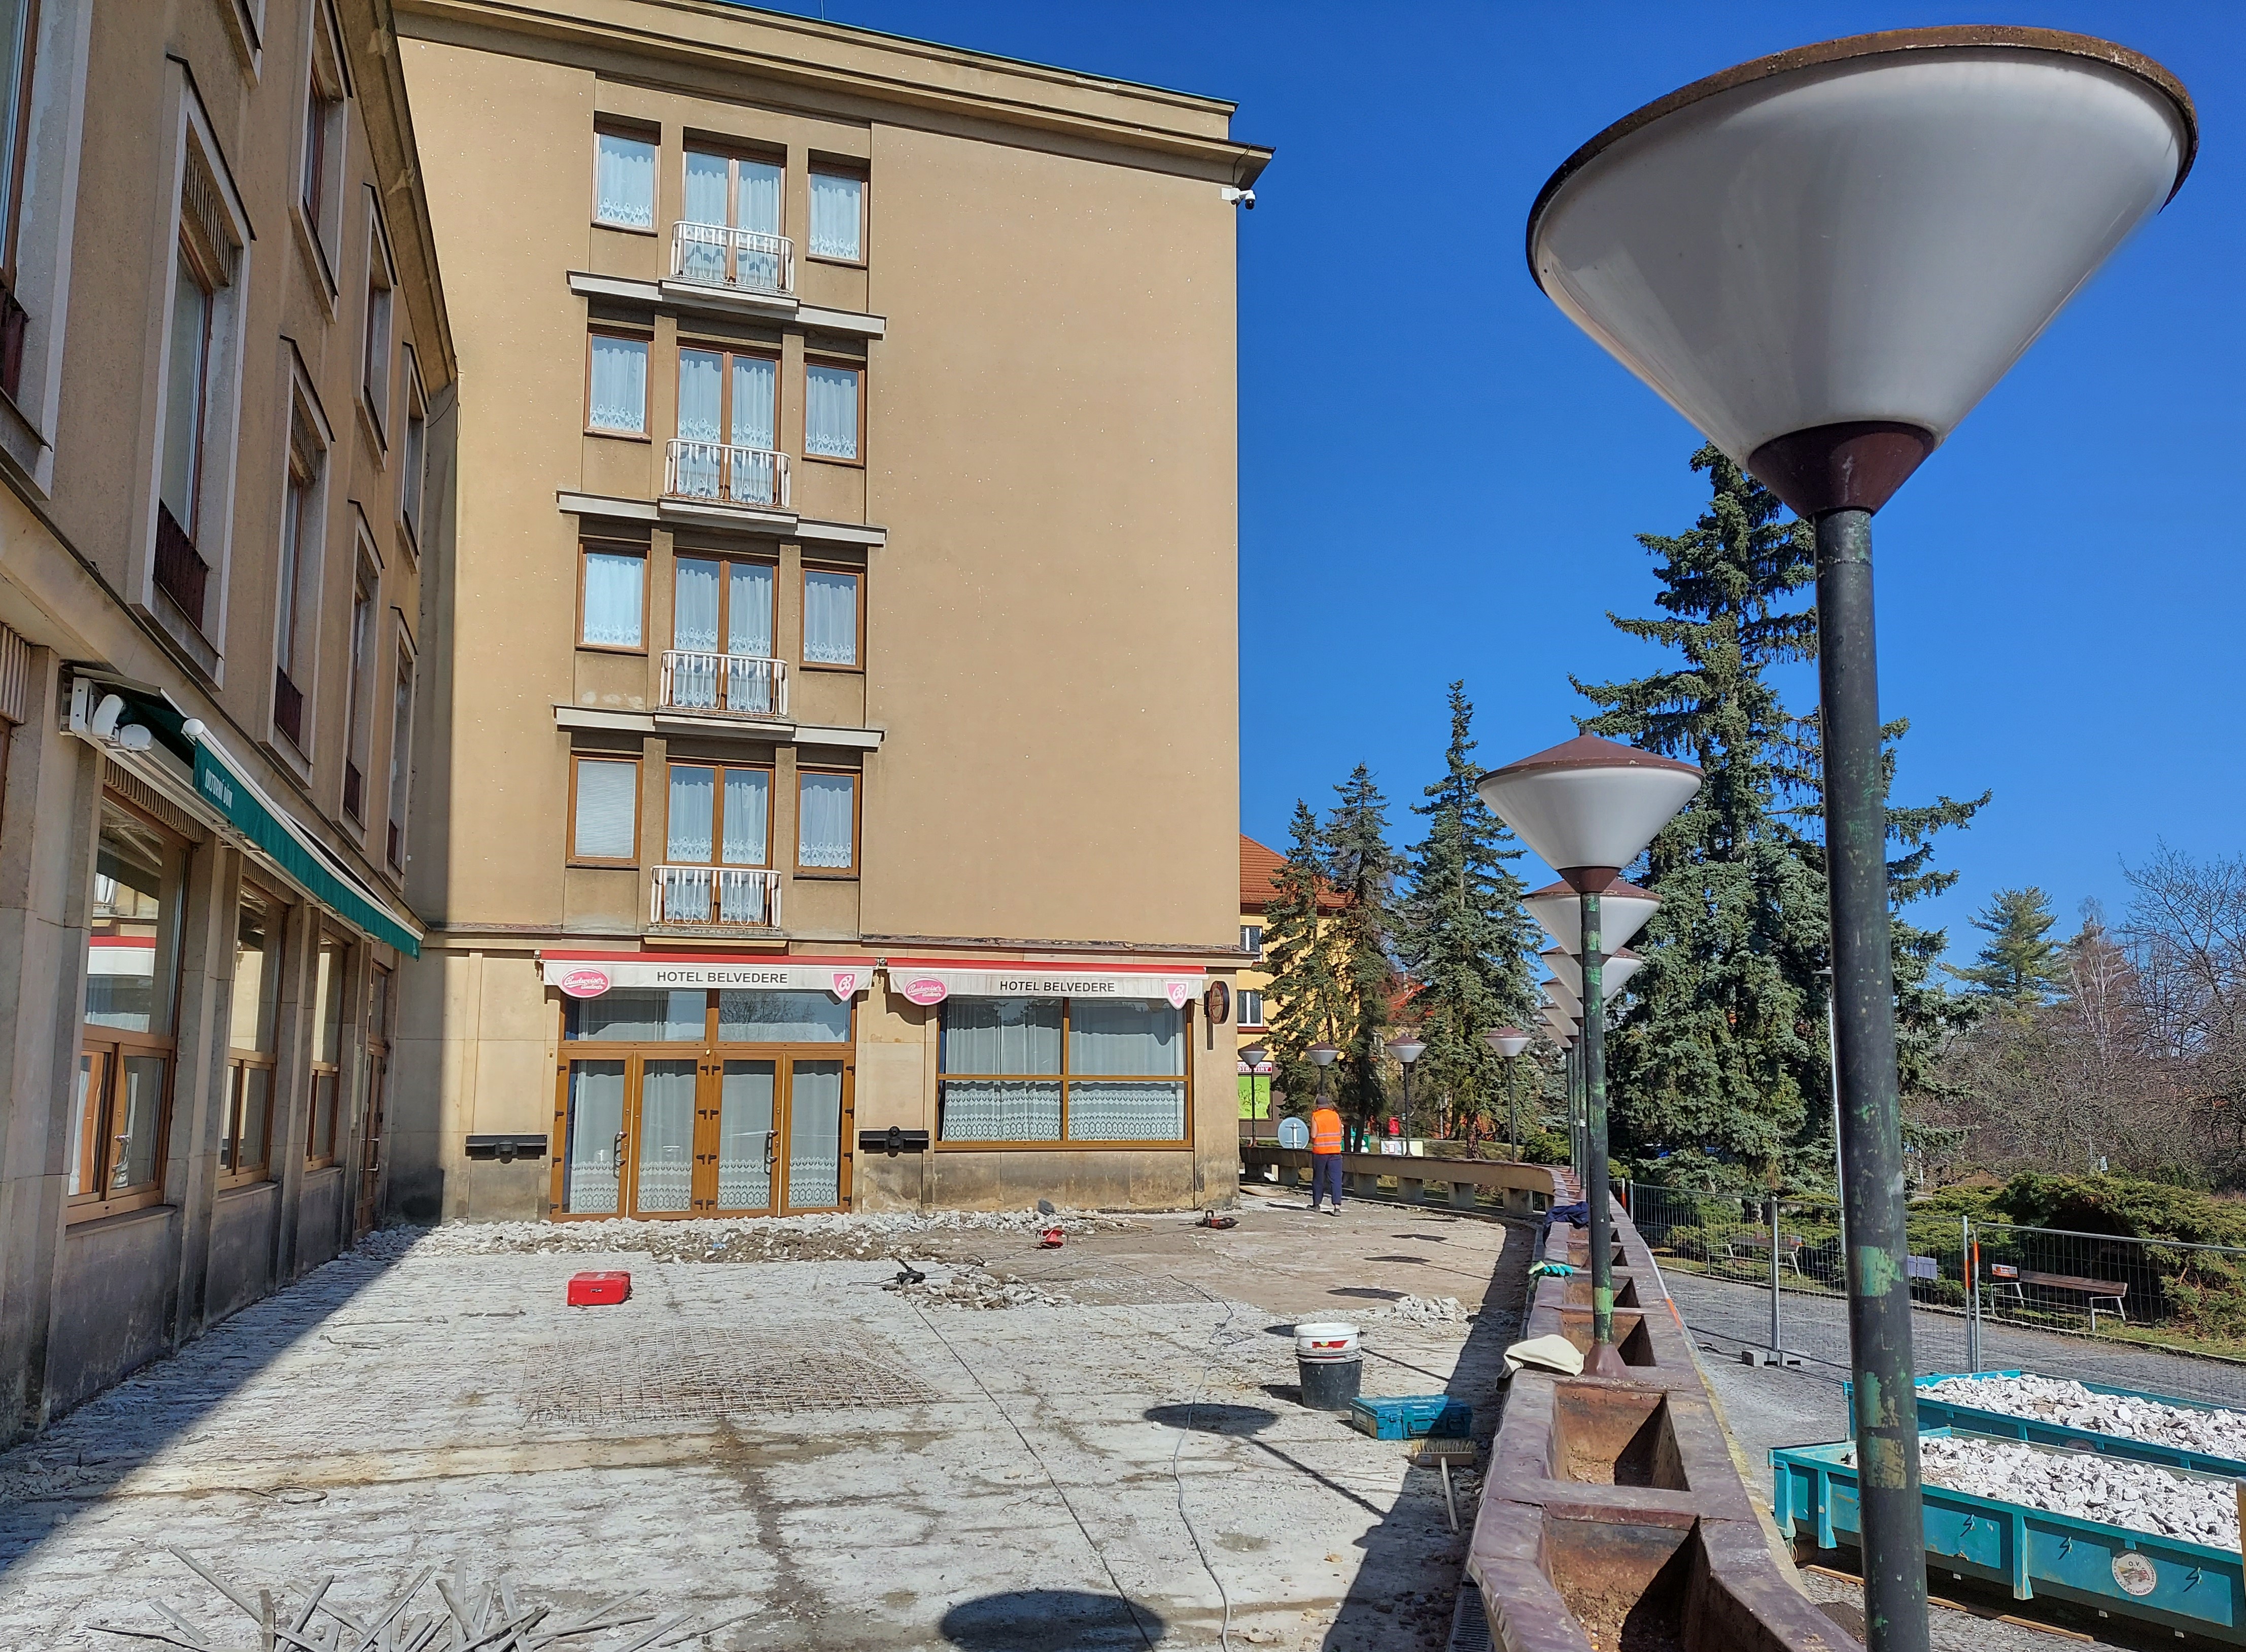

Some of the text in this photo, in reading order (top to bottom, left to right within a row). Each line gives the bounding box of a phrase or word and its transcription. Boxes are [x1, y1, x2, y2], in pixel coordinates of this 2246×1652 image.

[564, 975, 605, 988] Budweiser
[657, 971, 787, 983] HOTEL BELVEDERE
[907, 983, 944, 995] Budweiser
[999, 980, 1115, 992] HOTEL BELVEDERE
